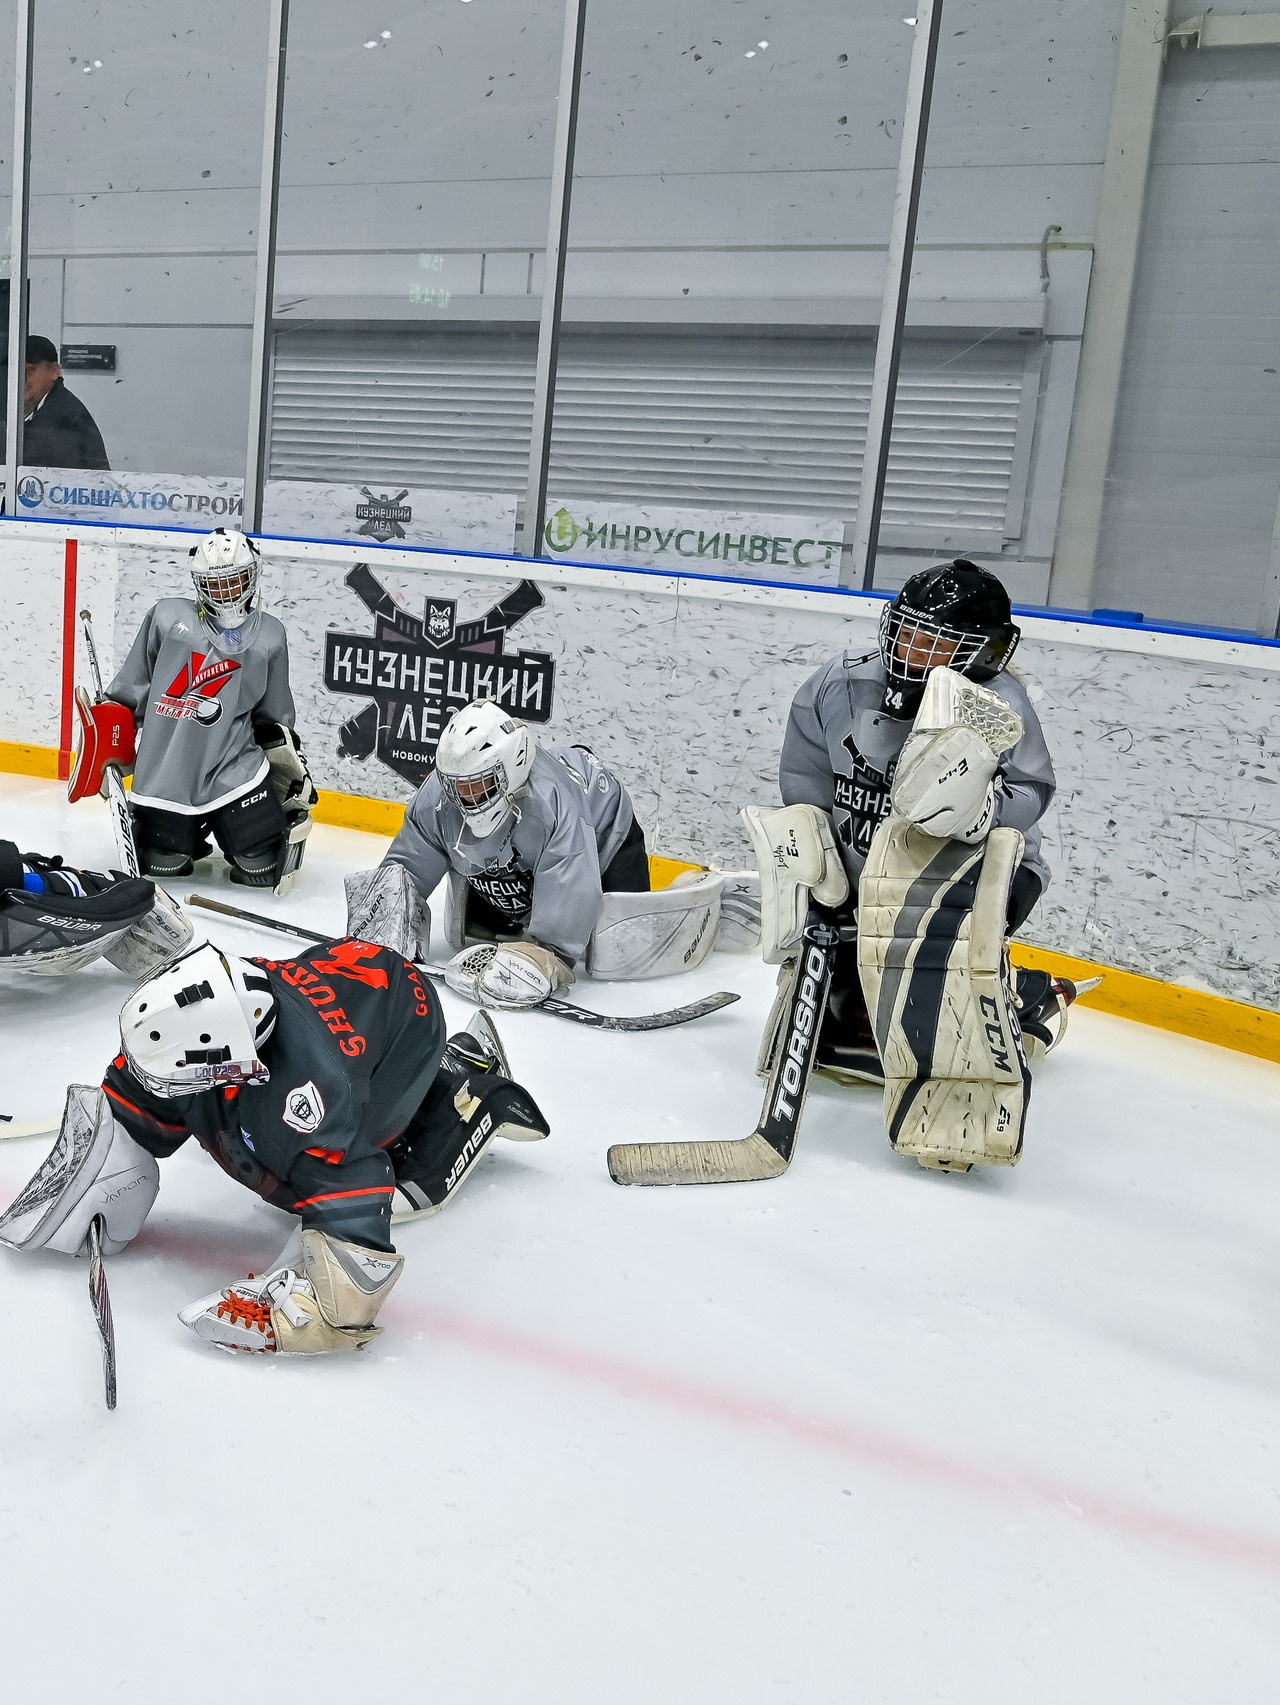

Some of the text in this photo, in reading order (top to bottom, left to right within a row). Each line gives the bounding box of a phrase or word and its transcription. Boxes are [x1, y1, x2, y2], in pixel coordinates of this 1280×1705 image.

[48, 485, 243, 516] СИБШАХТОСТРОЙ
[586, 519, 841, 569] ИНРУСИНВЕСТ
[899, 604, 934, 621] BAUER
[997, 632, 1019, 672] BAUER
[333, 645, 544, 711] КУЗНЕЦКИЙ
[397, 698, 442, 745] ЛЁ
[392, 749, 436, 765] НОВОКУ
[240, 790, 268, 808] CCM
[965, 795, 992, 838] CCM
[36, 914, 102, 932] BAUER
[353, 893, 384, 938] BAUER
[684, 907, 710, 964] BAUER
[772, 945, 826, 1122] TORSPO
[979, 994, 1013, 1074] CCM
[444, 1112, 493, 1191] BAUER
